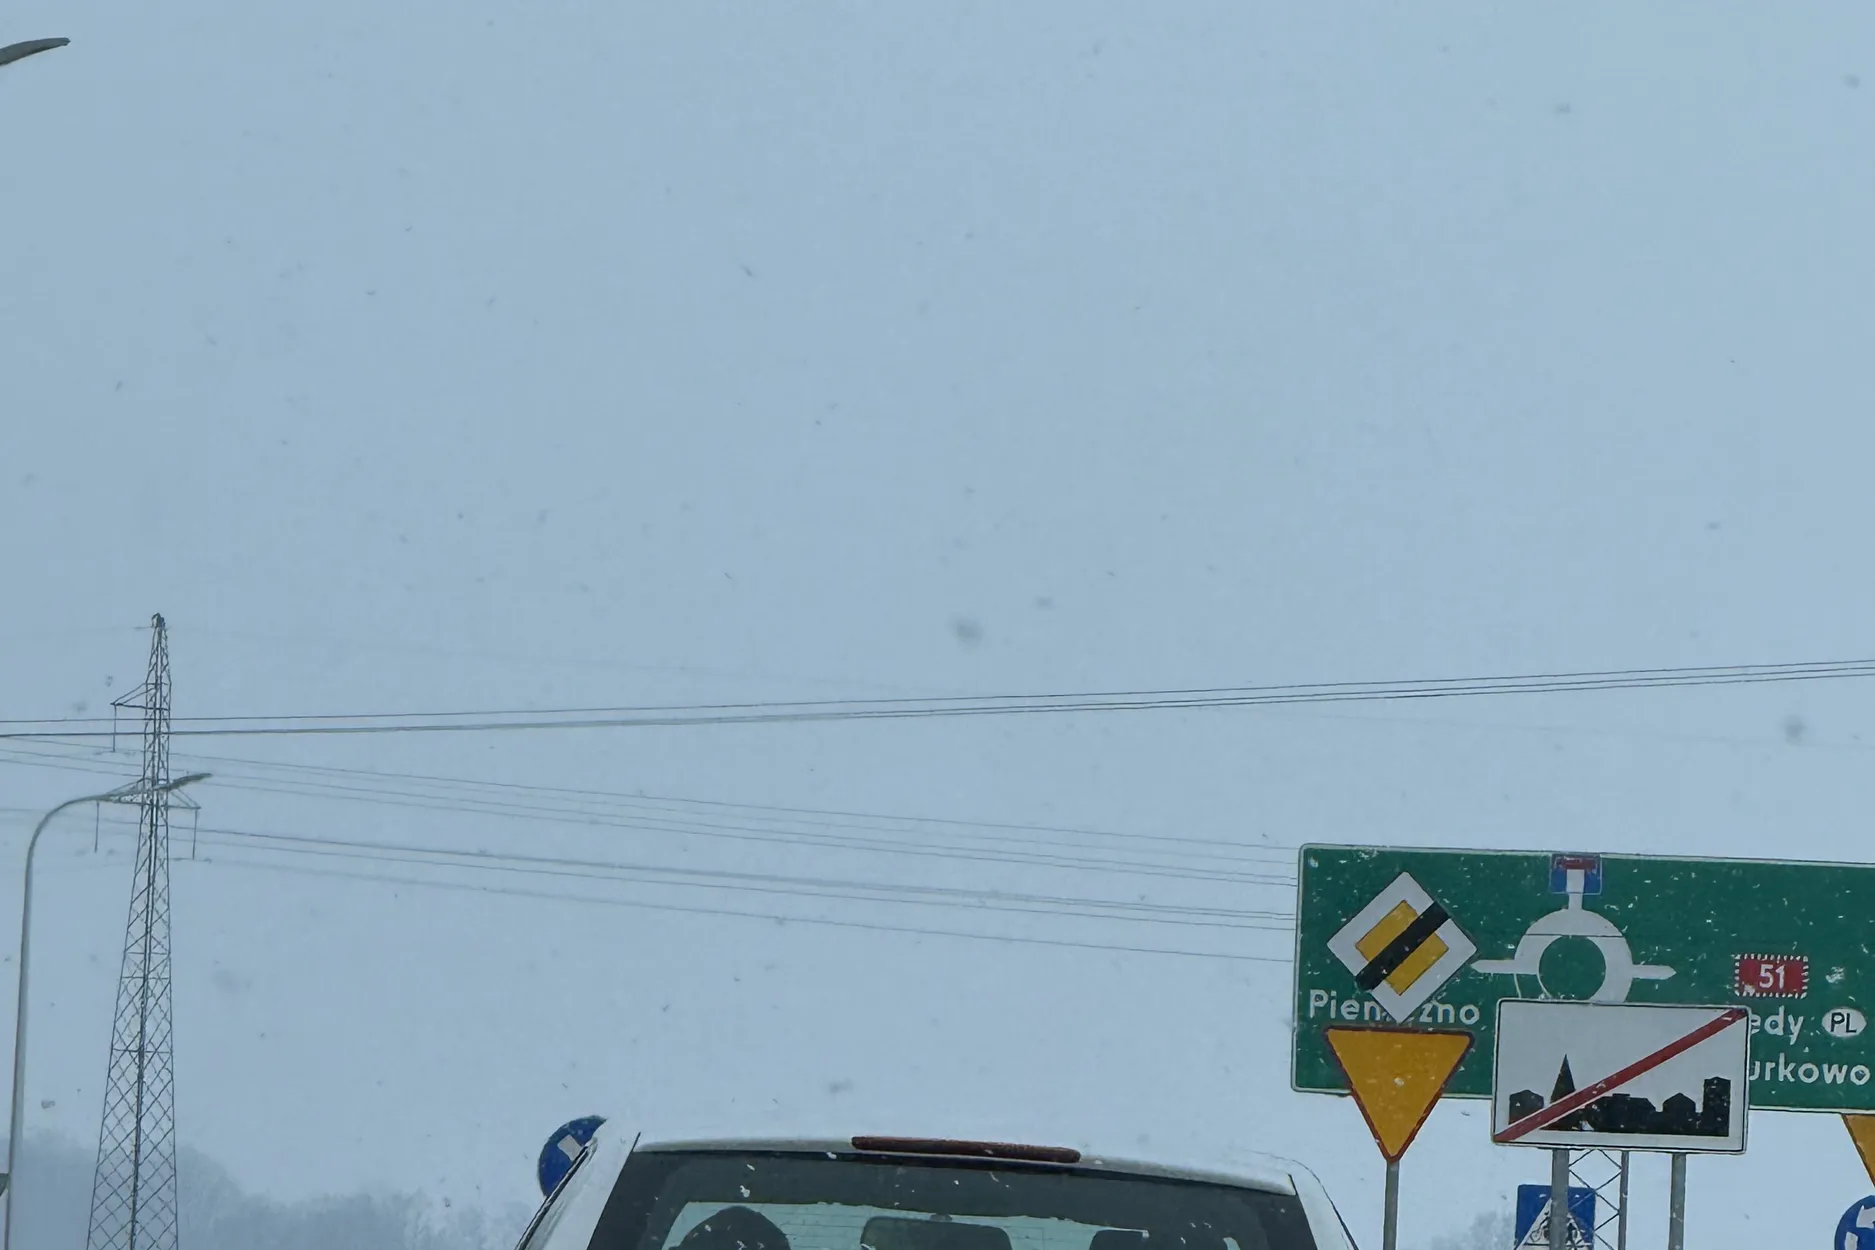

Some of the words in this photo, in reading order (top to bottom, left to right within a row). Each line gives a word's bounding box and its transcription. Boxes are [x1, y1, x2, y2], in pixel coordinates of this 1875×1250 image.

[1759, 963, 1785, 989] 51
[1749, 1005, 1804, 1045] edy
[1830, 1012, 1857, 1033] PL
[1748, 1052, 1871, 1086] urkowo
